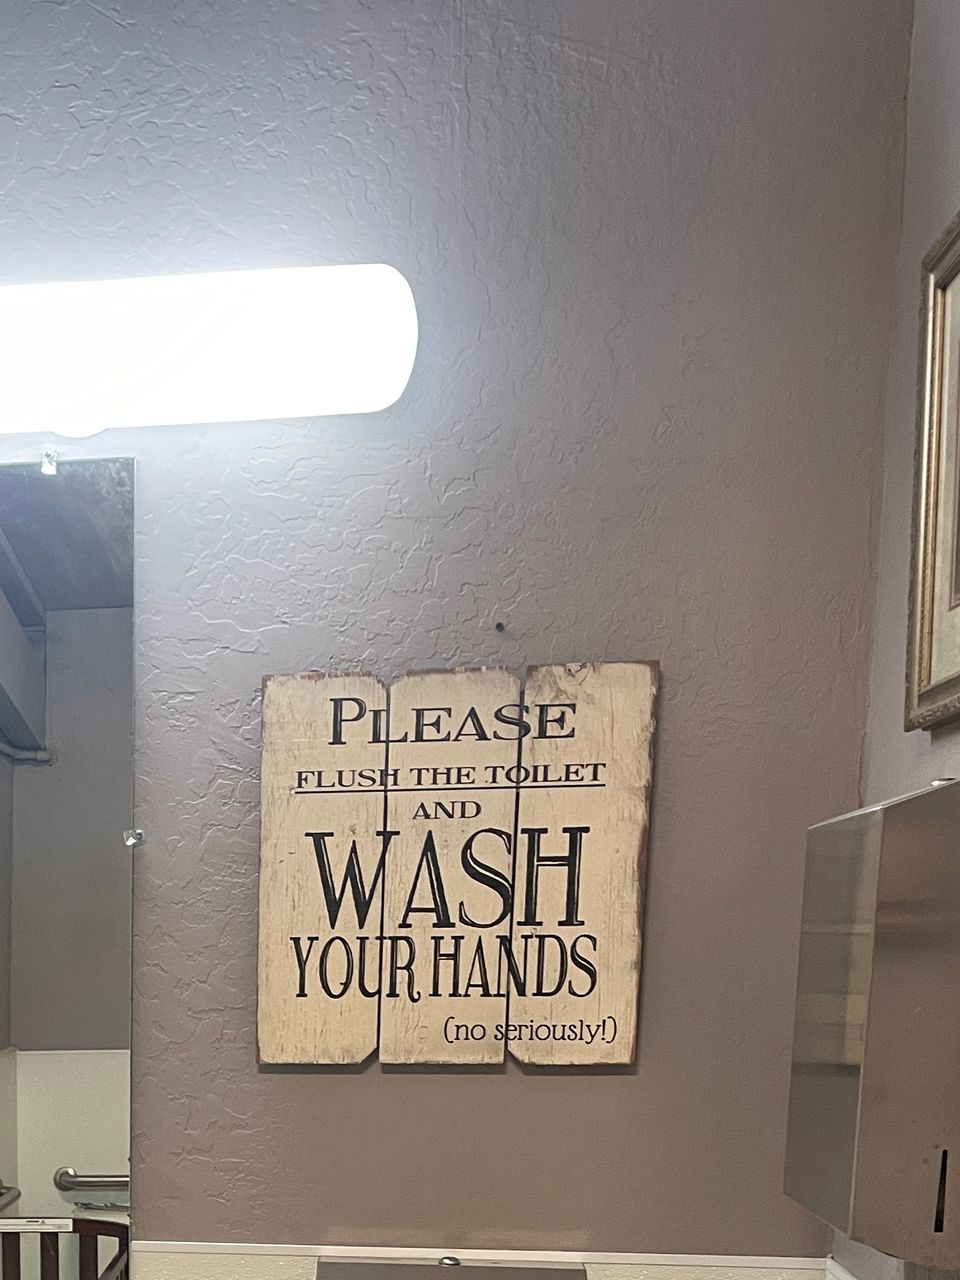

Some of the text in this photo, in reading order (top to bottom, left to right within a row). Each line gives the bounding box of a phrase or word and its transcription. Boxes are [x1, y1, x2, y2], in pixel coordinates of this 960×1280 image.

[328, 697, 577, 746] PLEASE
[295, 763, 607, 789] FLUSH THE TOILET
[412, 801, 482, 820] AND
[304, 826, 591, 930] WASH
[290, 934, 598, 1003] YOUR HANDS
[443, 1016, 618, 1044] (no seriously!)
